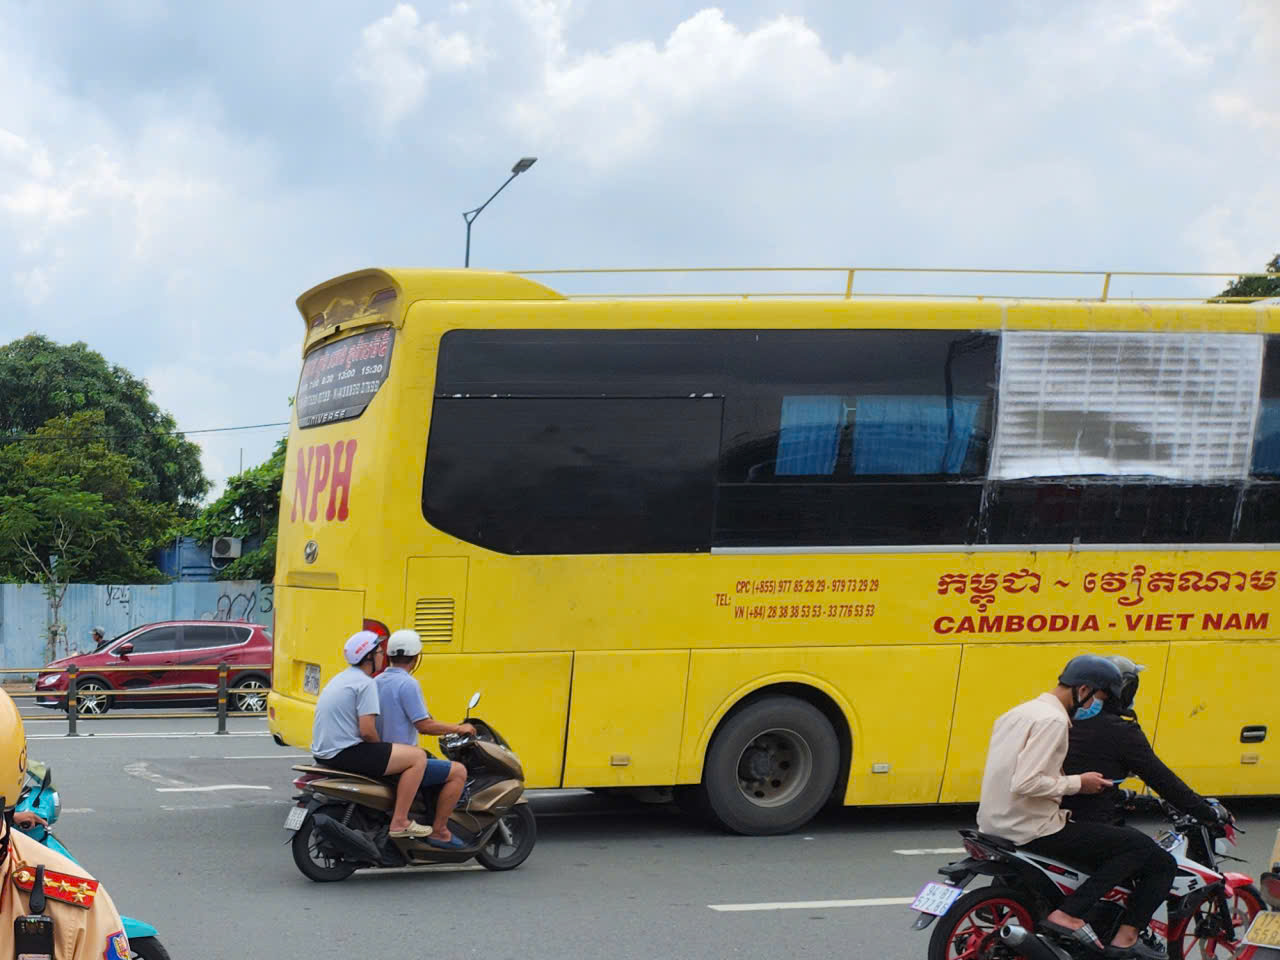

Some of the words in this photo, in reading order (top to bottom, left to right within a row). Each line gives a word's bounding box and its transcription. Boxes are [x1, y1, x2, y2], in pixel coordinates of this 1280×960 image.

[361, 364, 384, 376] 15:30
[290, 438, 358, 523] NPH
[736, 580, 751, 594] CPC
[752, 580, 776, 595] (+855)
[778, 579, 793, 593] 977
[804, 579, 815, 593] 29
[815, 579, 825, 593] 29
[832, 578, 846, 592] 979
[847, 578, 857, 592] 73
[858, 578, 868, 592] 29
[869, 578, 879, 592] 29
[715, 593, 732, 607] TEL:
[735, 605, 745, 618] VN
[746, 604, 766, 619] (+84)
[933, 614, 1100, 634] CAMBODIA
[1125, 613, 1195, 632] VIET
[1201, 612, 1270, 631] NAM
